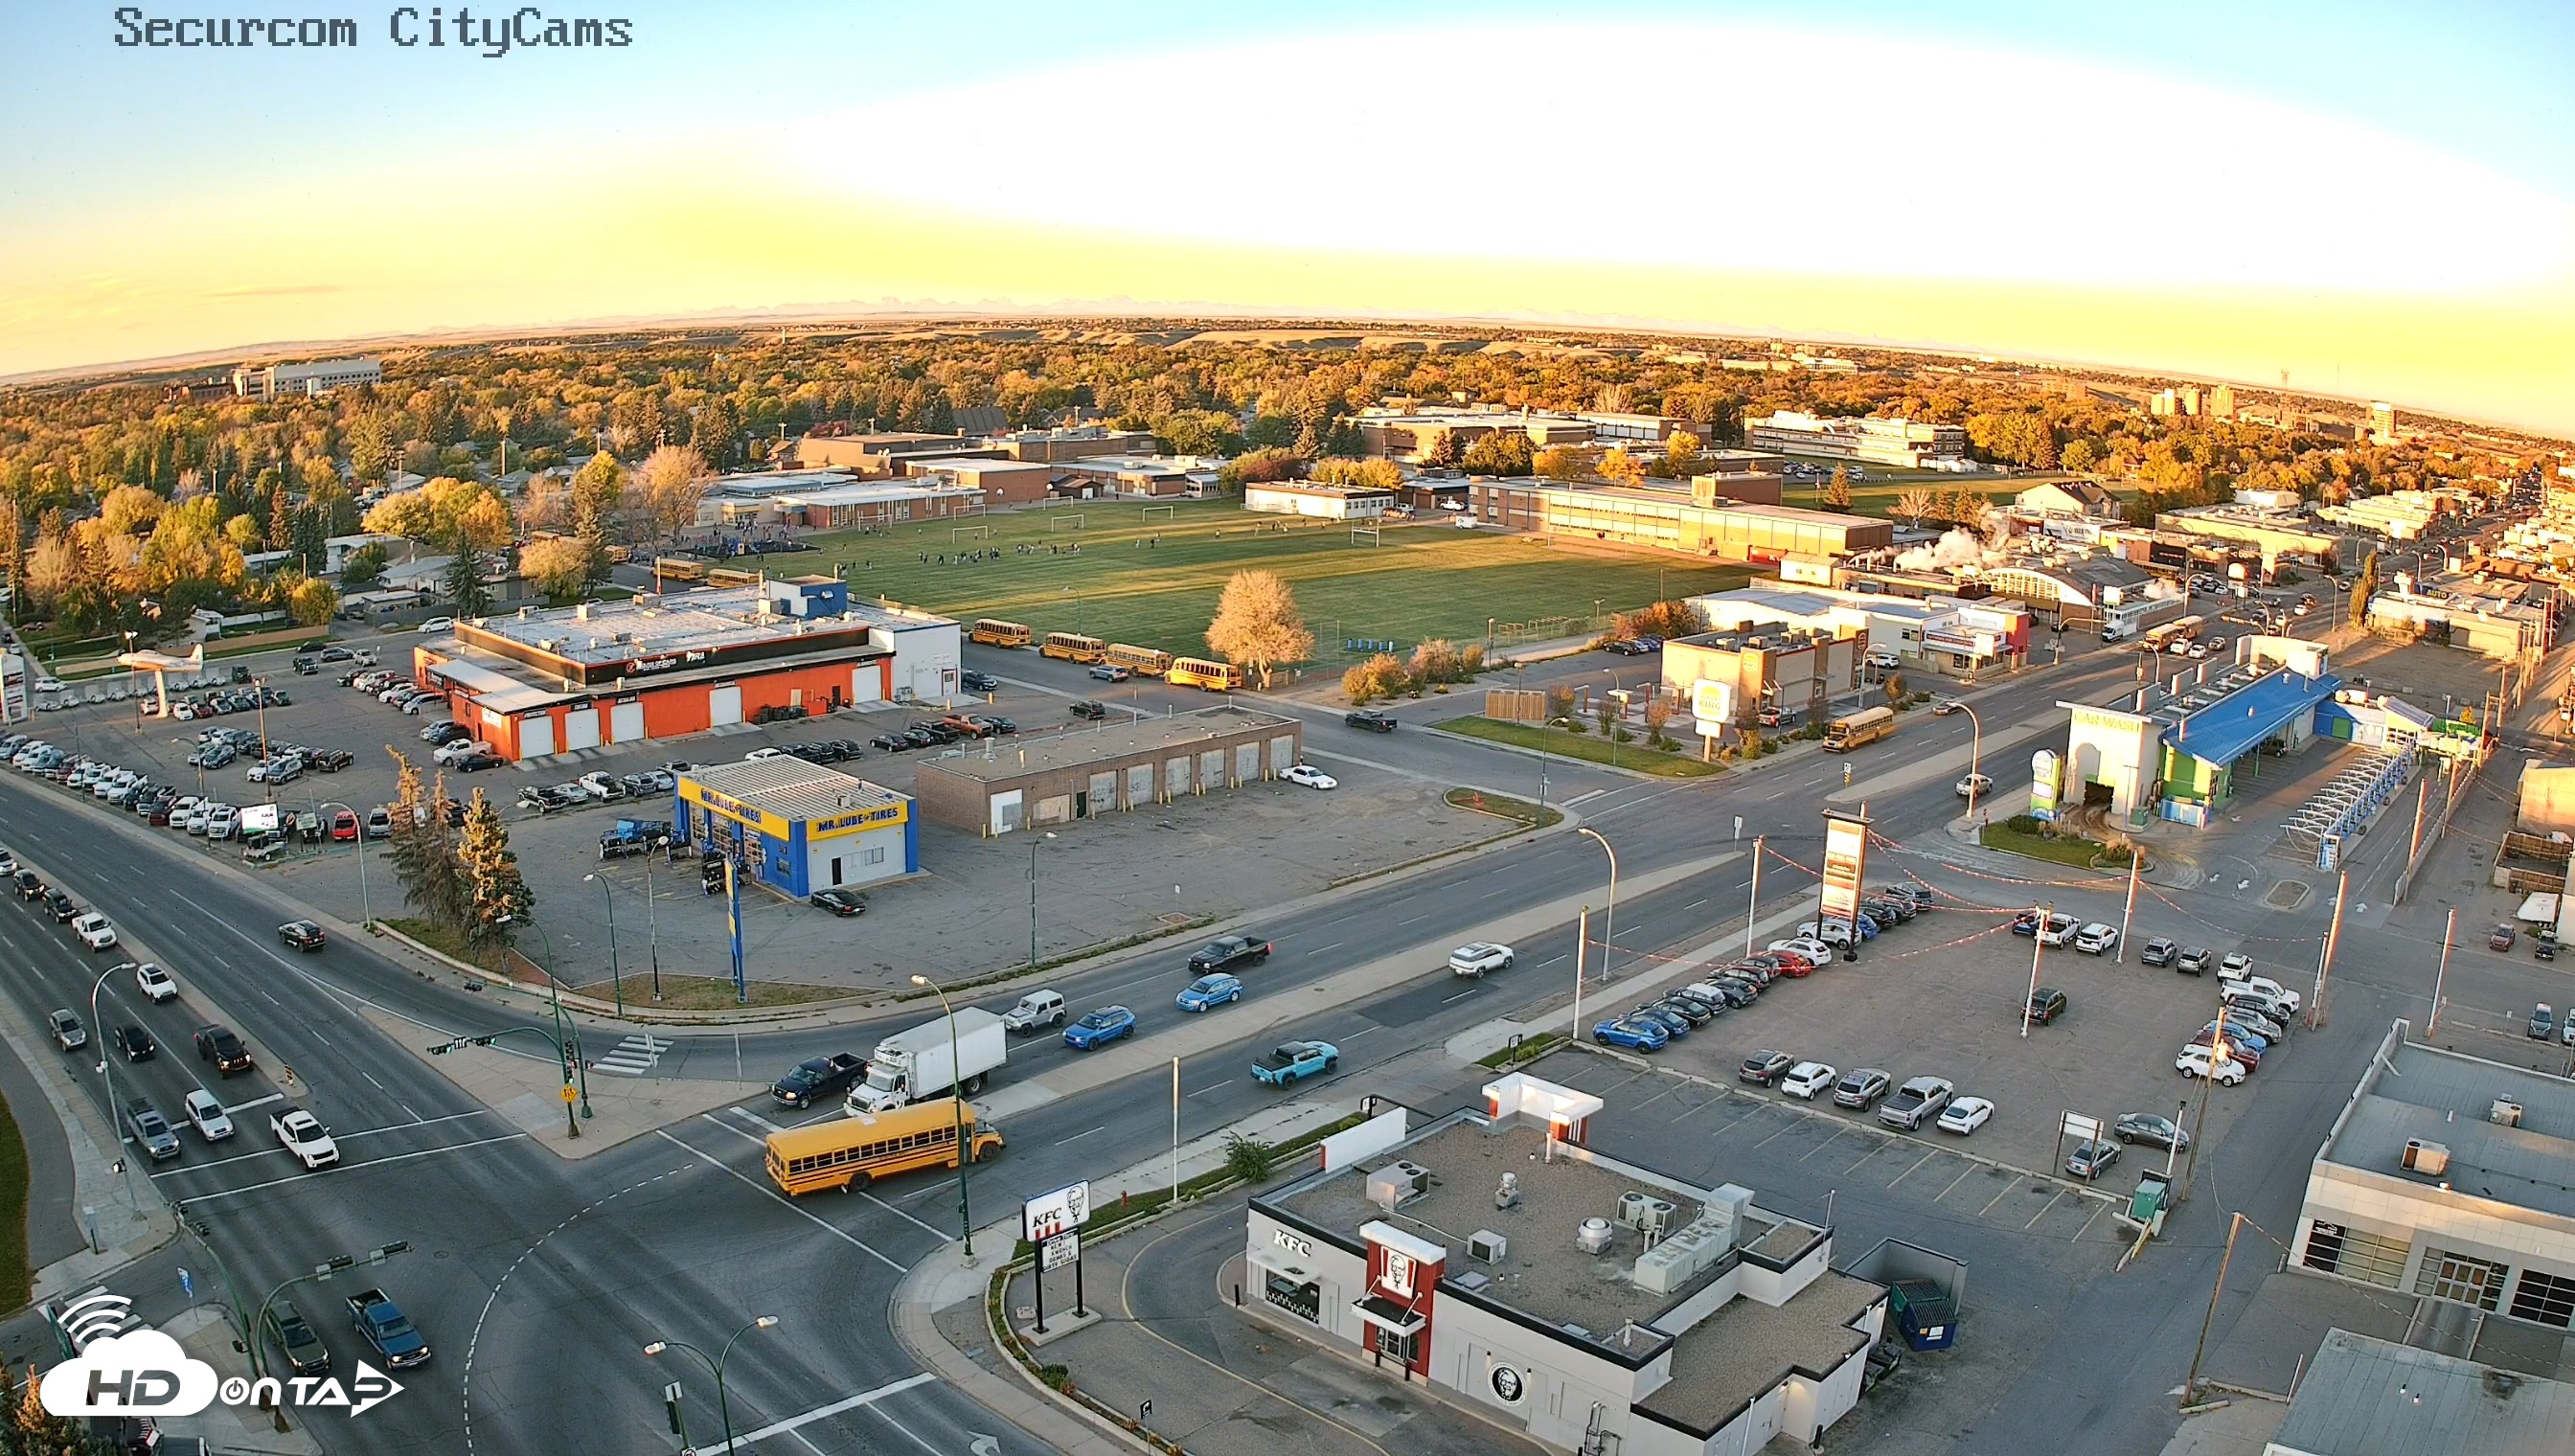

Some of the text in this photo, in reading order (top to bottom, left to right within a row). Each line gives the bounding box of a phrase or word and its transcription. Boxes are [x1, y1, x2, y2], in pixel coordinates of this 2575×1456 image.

[2427, 589, 2447, 599] AUTO
[838, 814, 864, 828] LUBE
[870, 807, 899, 821] TIRES
[1033, 1207, 1061, 1227] KFC
[1273, 1229, 1311, 1258] KFC
